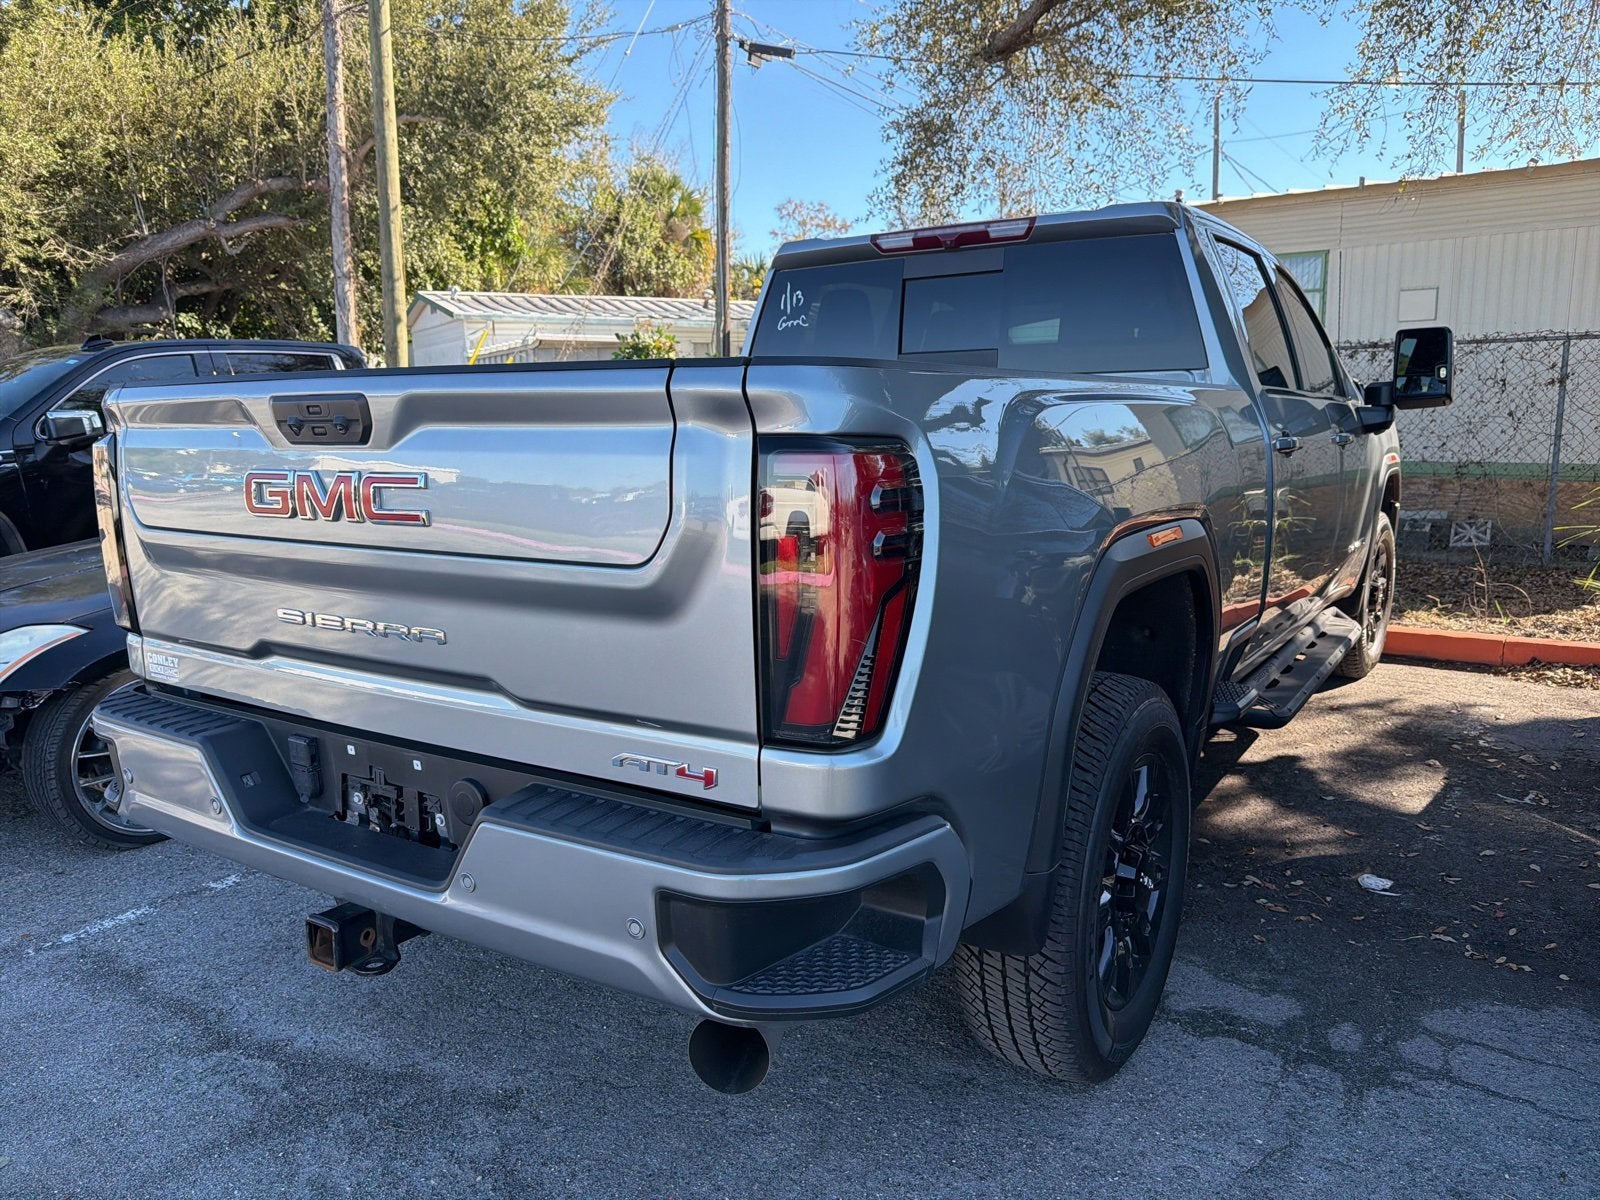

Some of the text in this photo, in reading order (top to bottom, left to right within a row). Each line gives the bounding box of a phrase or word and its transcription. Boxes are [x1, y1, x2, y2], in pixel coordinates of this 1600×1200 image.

[244, 469, 432, 527] GMC
[276, 607, 447, 646] SIERRA
[147, 652, 179, 668] CONLEY
[612, 752, 718, 790] AT4
